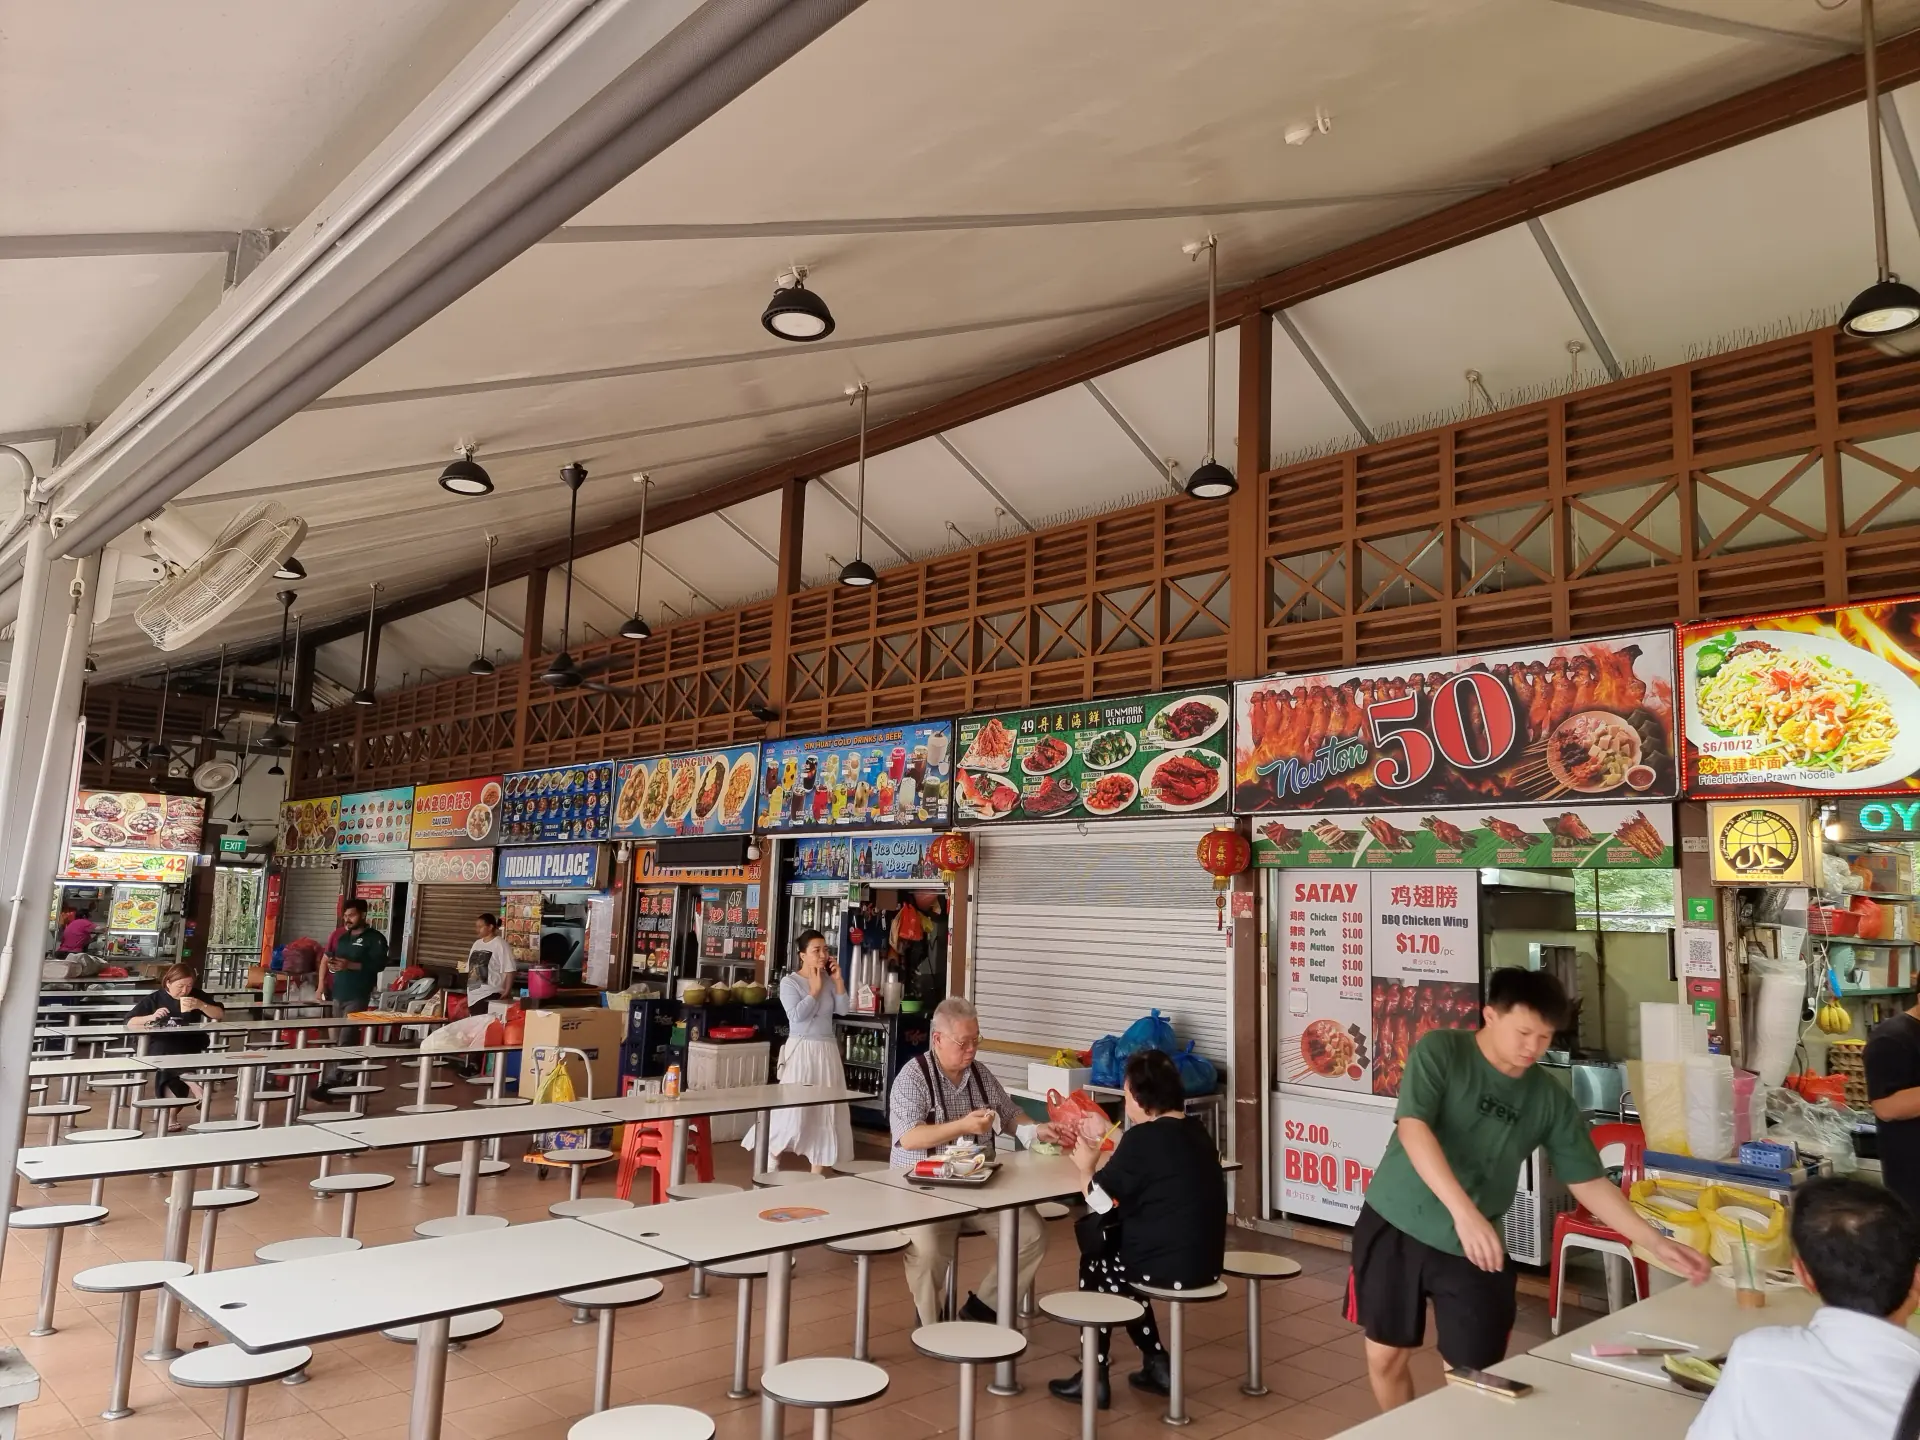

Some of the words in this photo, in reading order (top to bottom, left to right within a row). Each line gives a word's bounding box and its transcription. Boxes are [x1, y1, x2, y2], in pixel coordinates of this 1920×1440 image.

[1105, 705, 1144, 718] DENMARK
[1020, 720, 1034, 733] 49
[1107, 715, 1142, 726] SEAFOOD
[1366, 671, 1517, 790] 50
[804, 741, 816, 751] SIN
[815, 739, 834, 750] HUAT
[833, 738, 851, 747] COLD
[853, 735, 877, 746] DRINKS
[885, 731, 903, 741] BEER
[1702, 739, 1753, 753] $6/10/12
[672, 756, 714, 769] TANGLIN
[1268, 735, 1368, 798] Newton
[1699, 756, 1781, 774] 炒福建虾面
[619, 764, 633, 779] 47
[1699, 775, 1723, 785] Fried
[1725, 772, 1764, 784] Hokkien
[1766, 772, 1797, 782] Prawn
[1800, 770, 1836, 780] Noodle
[224, 841, 242, 851] EXIT
[873, 840, 890, 855] Ice
[892, 839, 918, 857] Cold
[165, 858, 186, 872] 42
[504, 855, 542, 878] INDIAN
[544, 852, 590, 877] PALACE
[885, 857, 913, 873] Beer
[729, 890, 742, 906] 47
[1295, 883, 1358, 903] SATAY
[1391, 885, 1458, 909] 鸡翅膀
[1290, 911, 1305, 921] 鸡肉
[1310, 912, 1338, 922] Chicken
[1342, 912, 1363, 923] $1.00
[1382, 914, 1400, 926] BBQ
[1402, 915, 1441, 927] Chicken
[1443, 917, 1469, 928] Wing
[707, 925, 729, 937] OYSTER
[1310, 928, 1326, 937] Pork
[1342, 927, 1363, 939] $1.00
[1290, 941, 1305, 952] 羊肉
[1310, 943, 1335, 952] Mutton
[1342, 943, 1363, 955] $1.00
[1290, 957, 1305, 967] 牛肉
[1310, 958, 1326, 967] Beef
[1342, 959, 1363, 971] $1.00
[1309, 974, 1338, 984] Ketupat
[1342, 975, 1363, 987] $1.00
[1285, 1148, 1338, 1193] BBQ
[1321, 1198, 1349, 1209] Minimum
